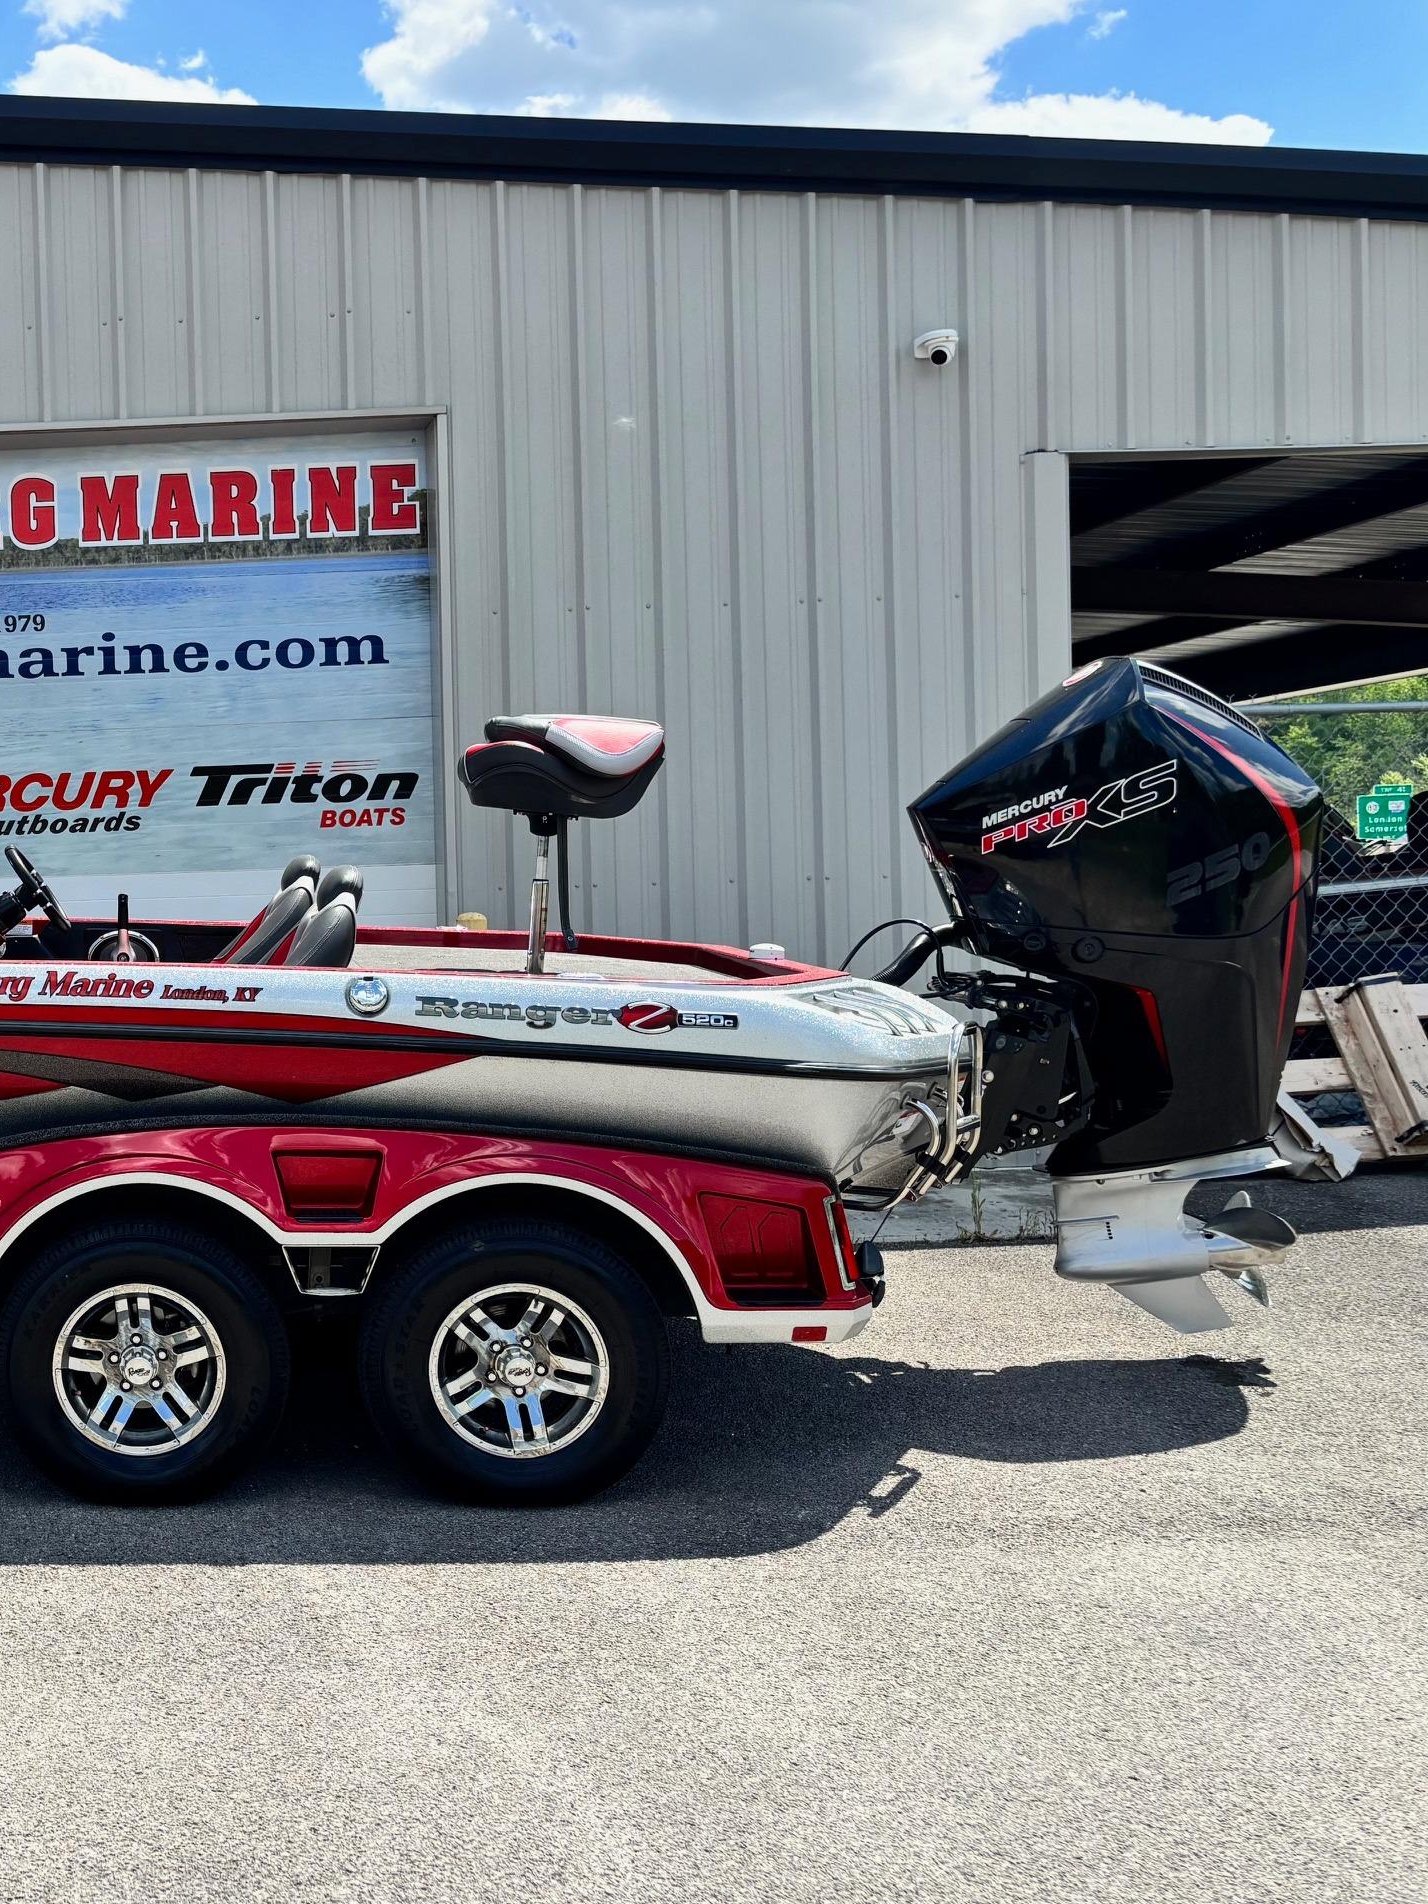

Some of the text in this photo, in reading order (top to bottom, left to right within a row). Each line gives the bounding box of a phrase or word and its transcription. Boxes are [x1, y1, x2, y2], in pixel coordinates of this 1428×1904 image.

[77, 459, 421, 548] MARINE
[190, 759, 420, 807] Triton
[319, 807, 406, 828] BOATS
[982, 785, 1069, 828] MERCURY
[1166, 831, 1272, 907] 250
[37, 970, 155, 1000] Marine
[159, 984, 230, 1004] London,
[232, 986, 264, 1003] KY
[415, 995, 622, 1030] Ranger
